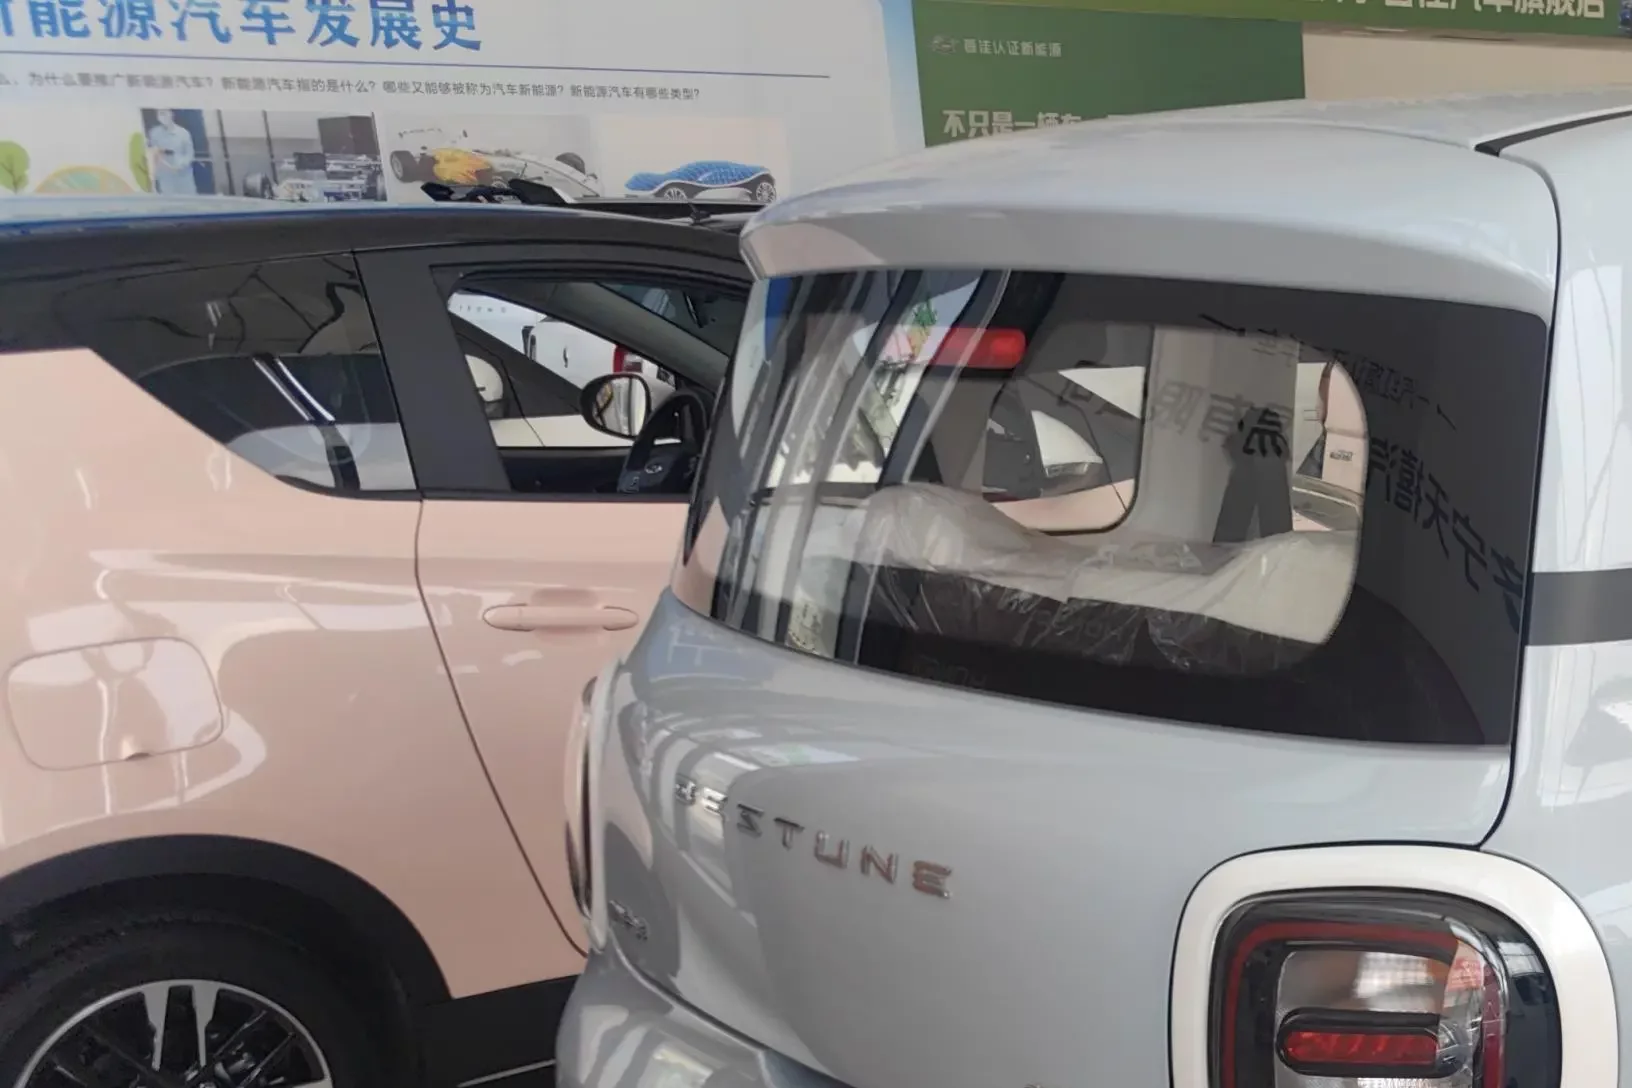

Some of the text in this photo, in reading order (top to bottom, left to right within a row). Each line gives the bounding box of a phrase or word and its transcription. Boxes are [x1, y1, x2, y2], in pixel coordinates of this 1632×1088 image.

[0, 0, 481, 51] 能源汽车发展史
